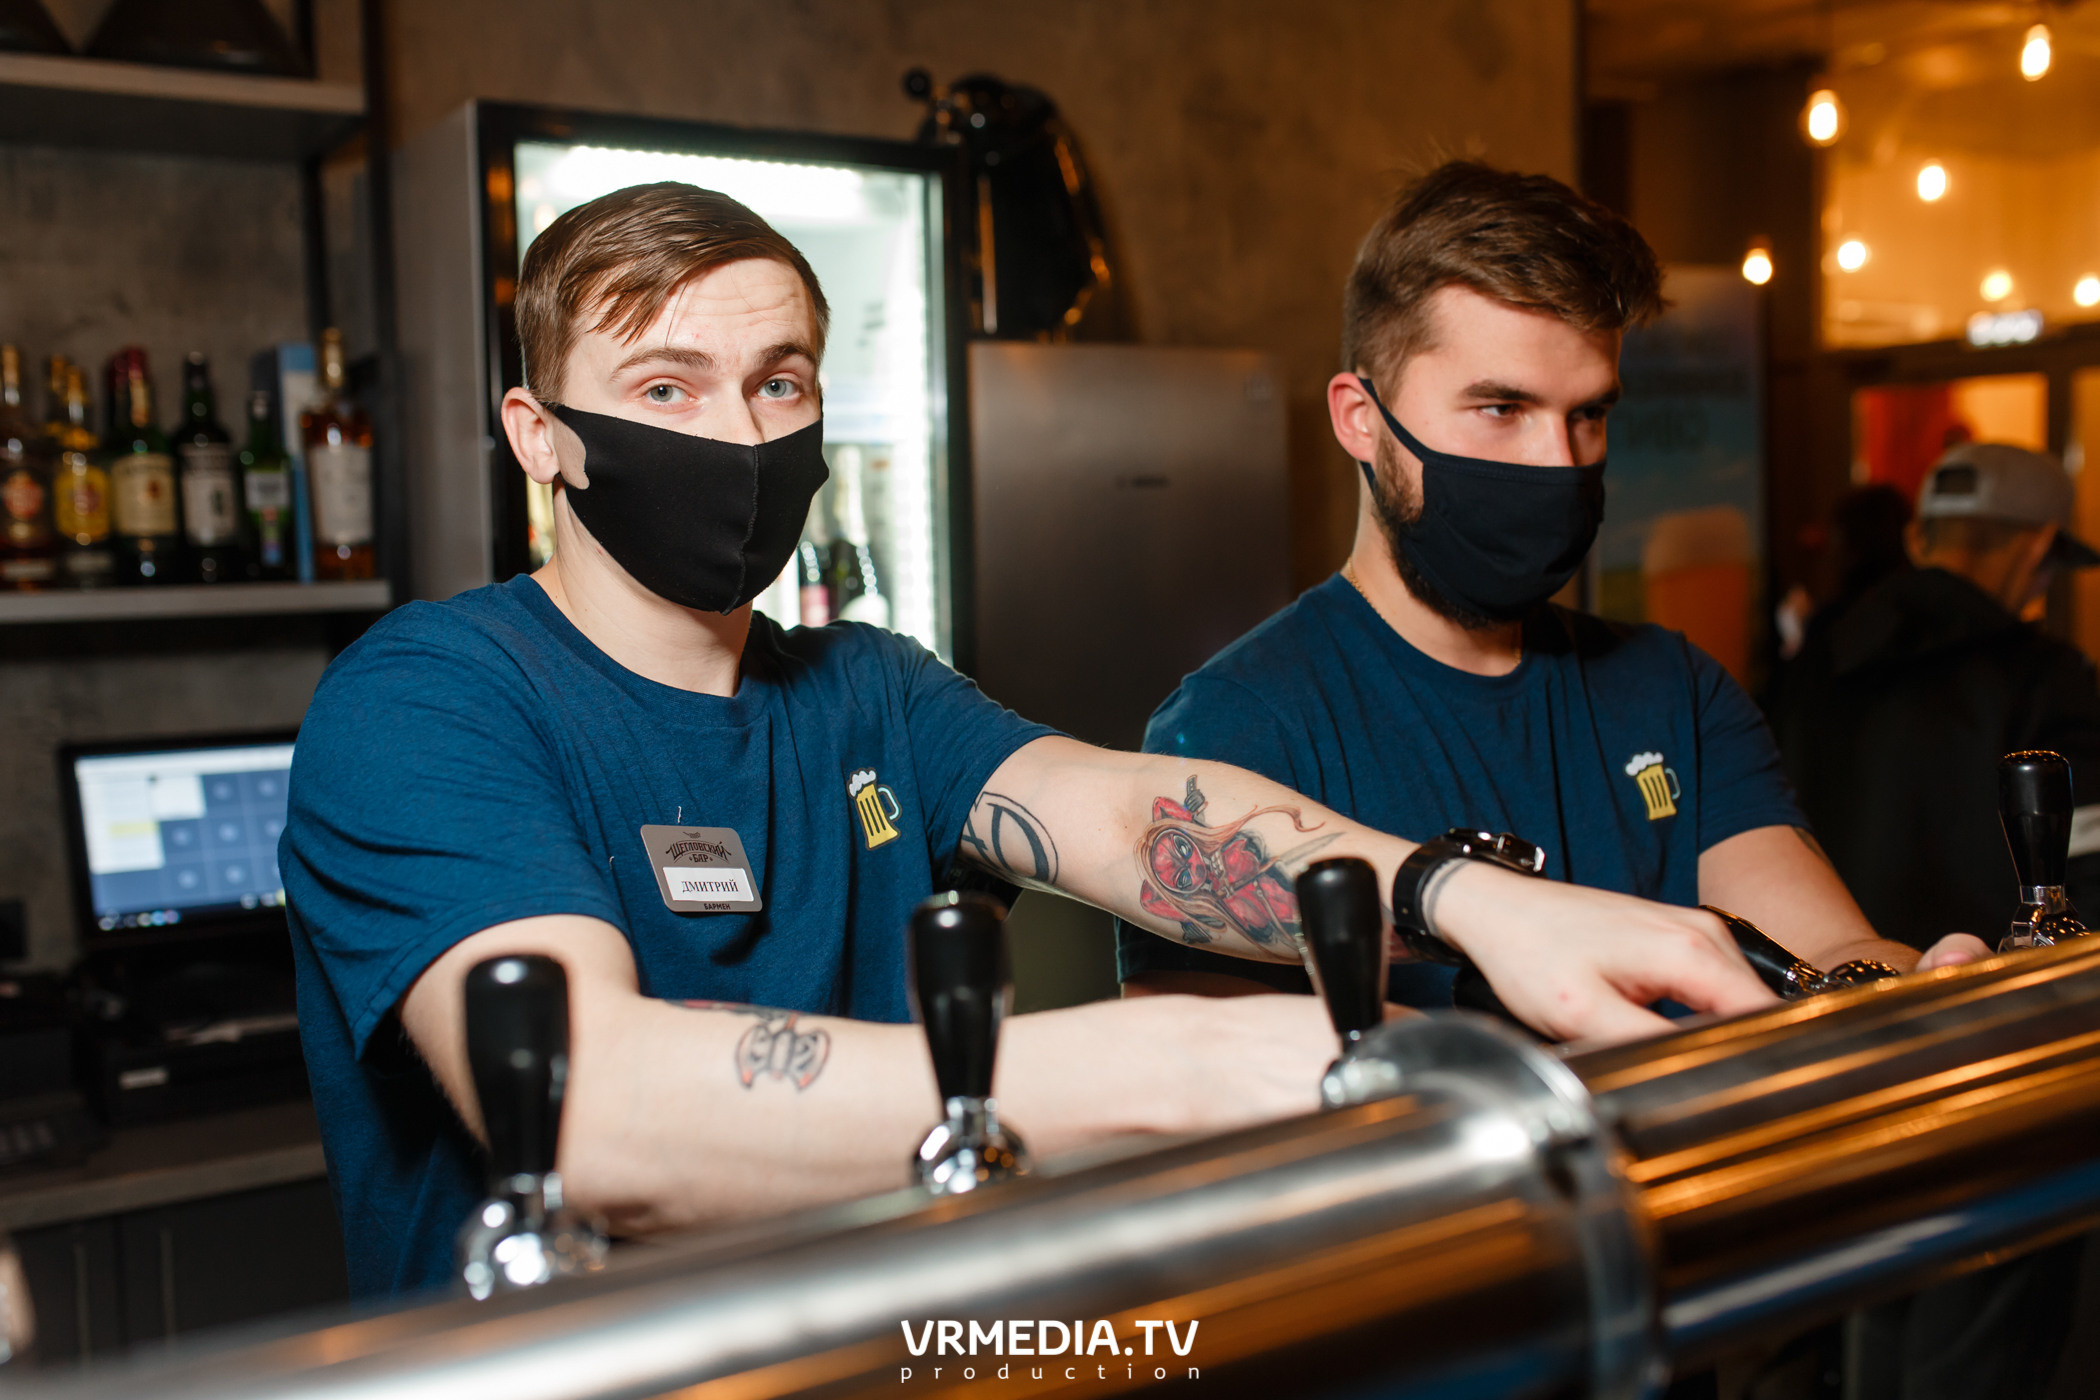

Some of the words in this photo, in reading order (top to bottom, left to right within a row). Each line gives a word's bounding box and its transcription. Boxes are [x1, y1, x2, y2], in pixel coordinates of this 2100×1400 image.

[666, 841, 731, 861] ЩЕГЛОВСКИЙ
[693, 853, 709, 863] БАР
[681, 878, 739, 893] ДМИТРИЙ
[704, 903, 731, 911] БАРМЕН
